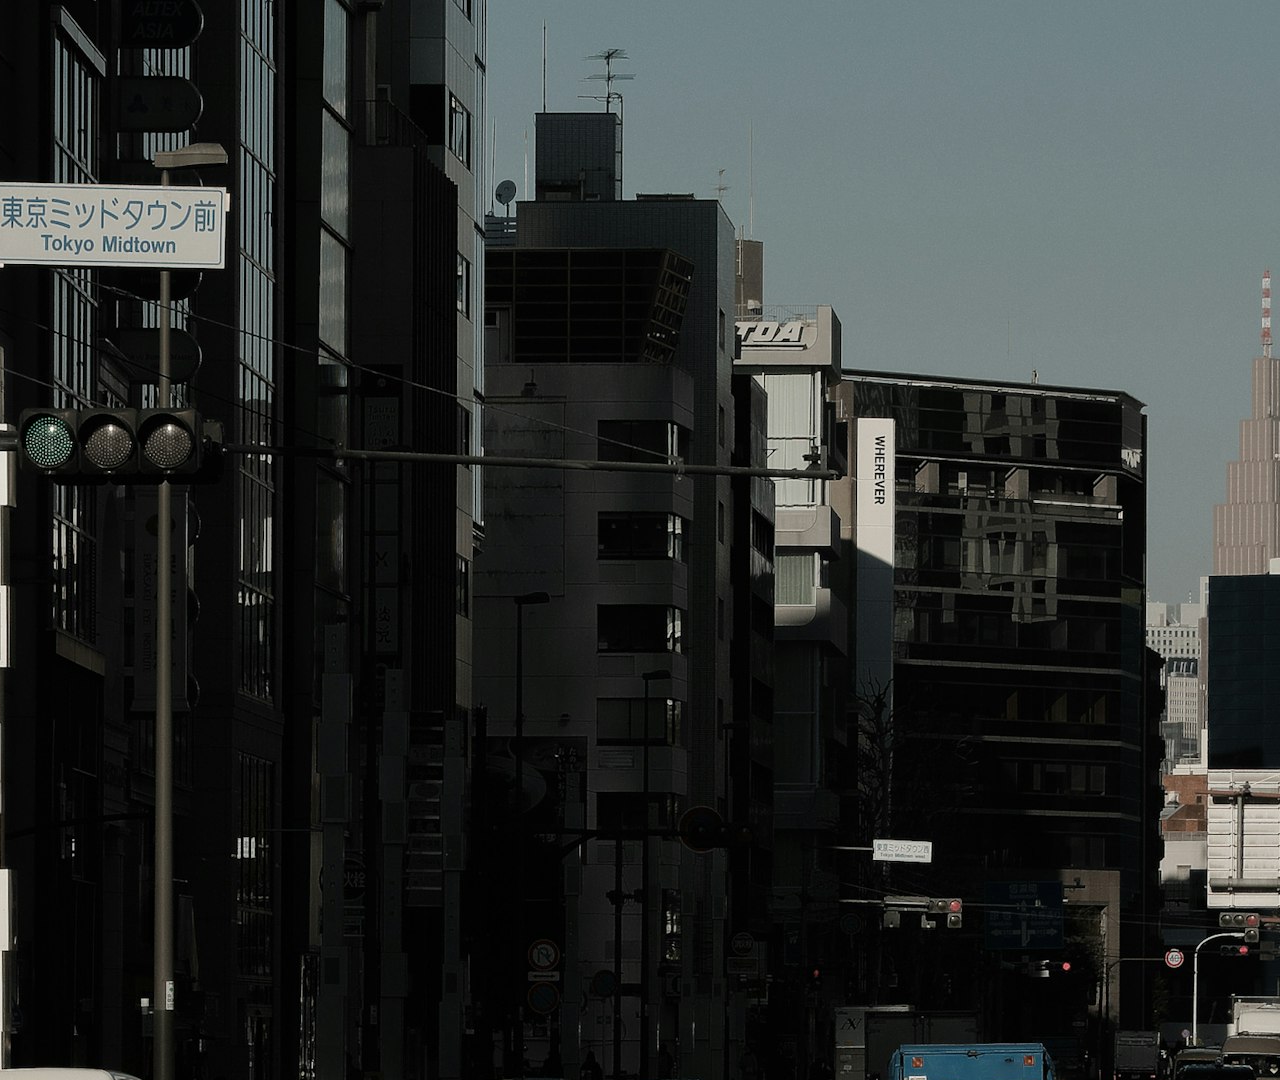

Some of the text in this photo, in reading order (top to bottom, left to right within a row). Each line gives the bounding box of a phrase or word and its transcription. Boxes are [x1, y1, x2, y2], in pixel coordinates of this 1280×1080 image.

[131, 22, 175, 39] ASIA
[0, 196, 217, 233] 東京ミッドタウン前
[40, 234, 177, 255] Tokyo Midtown
[874, 435, 886, 505] WHEREVER
[143, 608, 153, 625] EYE
